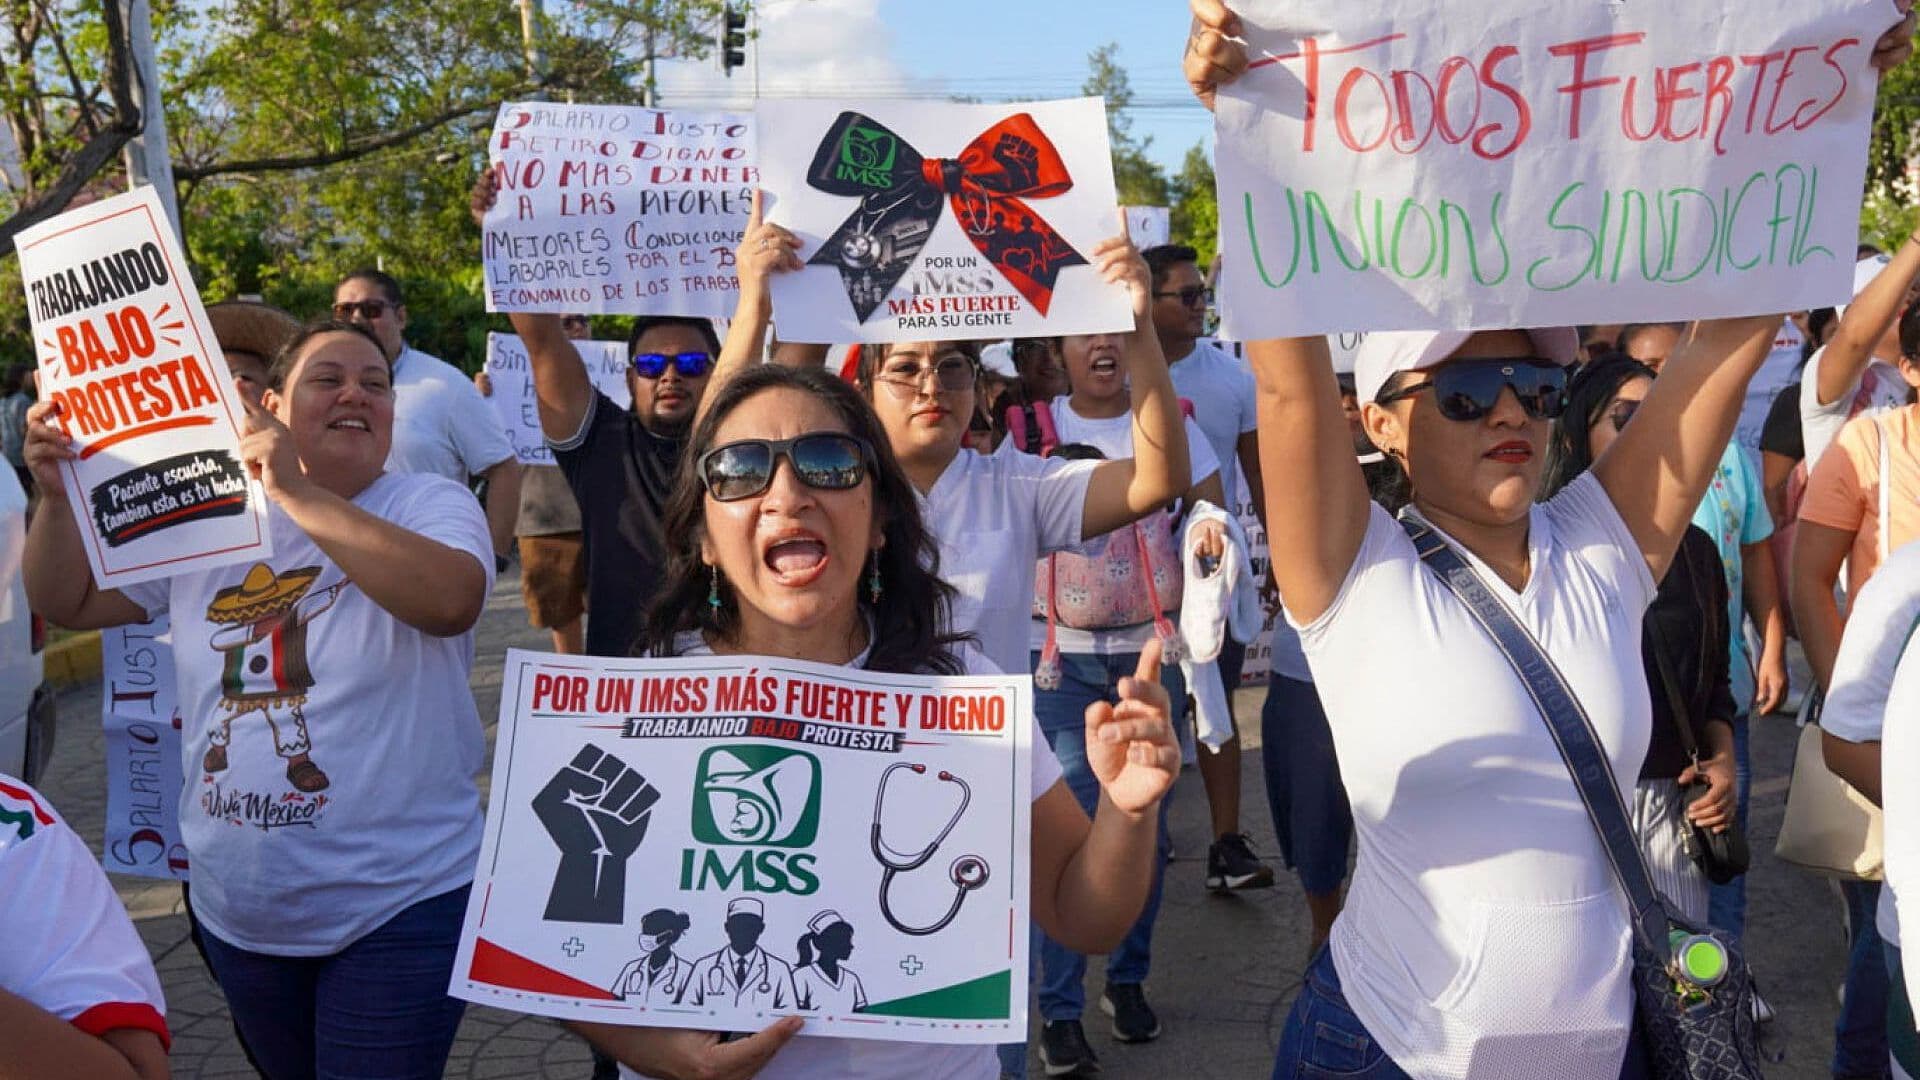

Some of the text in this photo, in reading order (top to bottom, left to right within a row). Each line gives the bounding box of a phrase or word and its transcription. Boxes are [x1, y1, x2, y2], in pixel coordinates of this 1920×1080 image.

[1248, 32, 1860, 160] TODOS FUERTES
[501, 106, 630, 132] SALARIO
[500, 131, 746, 161] RETIRO DIGNO
[495, 158, 760, 191] NO MAS DINER
[835, 165, 894, 188] IMSS
[518, 194, 535, 221] A
[559, 191, 616, 217] LAS
[486, 220, 745, 261] MEJORES CONDICIONE
[1244, 163, 1836, 292] UNION SINDICAL
[493, 256, 612, 285] LABORALES
[626, 250, 669, 271] POR
[680, 250, 706, 267] EL
[925, 256, 977, 269] POR UN
[31, 242, 168, 323] TRABAJANDO
[492, 275, 741, 306] ECONOMICO DE LOS TRABA
[913, 269, 994, 295] IMSS
[888, 294, 1020, 315] MÁS FUERTE
[898, 312, 1013, 329] PARA SU GENTE
[56, 305, 156, 377] BAJO
[51, 354, 218, 437] PROTESTA
[108, 472, 161, 508] Paciente
[180, 489, 194, 506] es
[194, 482, 212, 502] tu
[111, 620, 158, 714] JUST
[532, 667, 1005, 732] POR UN IMSS MÁS FUERTE Y DIGNO
[631, 717, 895, 751] TRABAJANDO BAJO PROTESTA
[205, 783, 240, 818] Viva
[680, 848, 820, 895] IMSS
